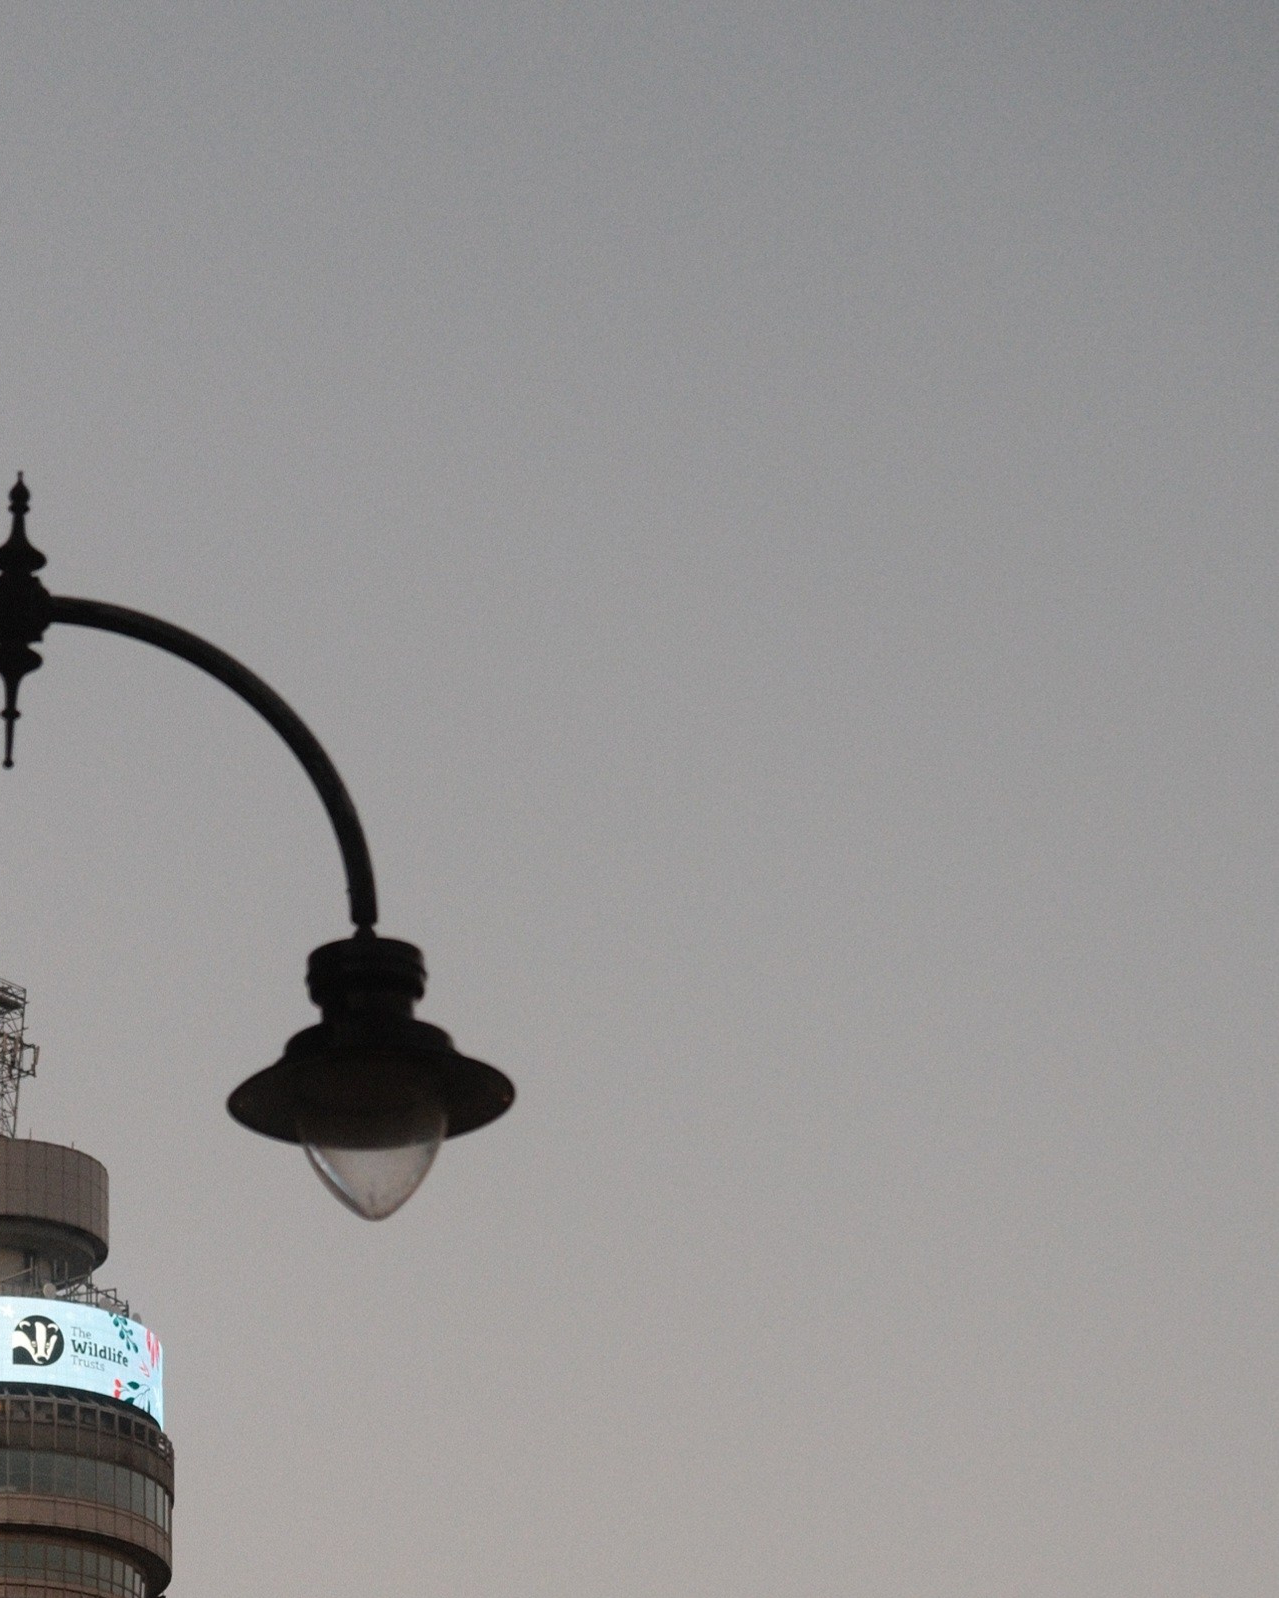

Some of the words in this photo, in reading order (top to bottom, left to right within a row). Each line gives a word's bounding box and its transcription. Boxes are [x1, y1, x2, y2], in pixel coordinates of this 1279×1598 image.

[70, 1326, 92, 1339] The
[71, 1339, 129, 1367] Wildlife
[70, 1354, 105, 1372] Trusts
